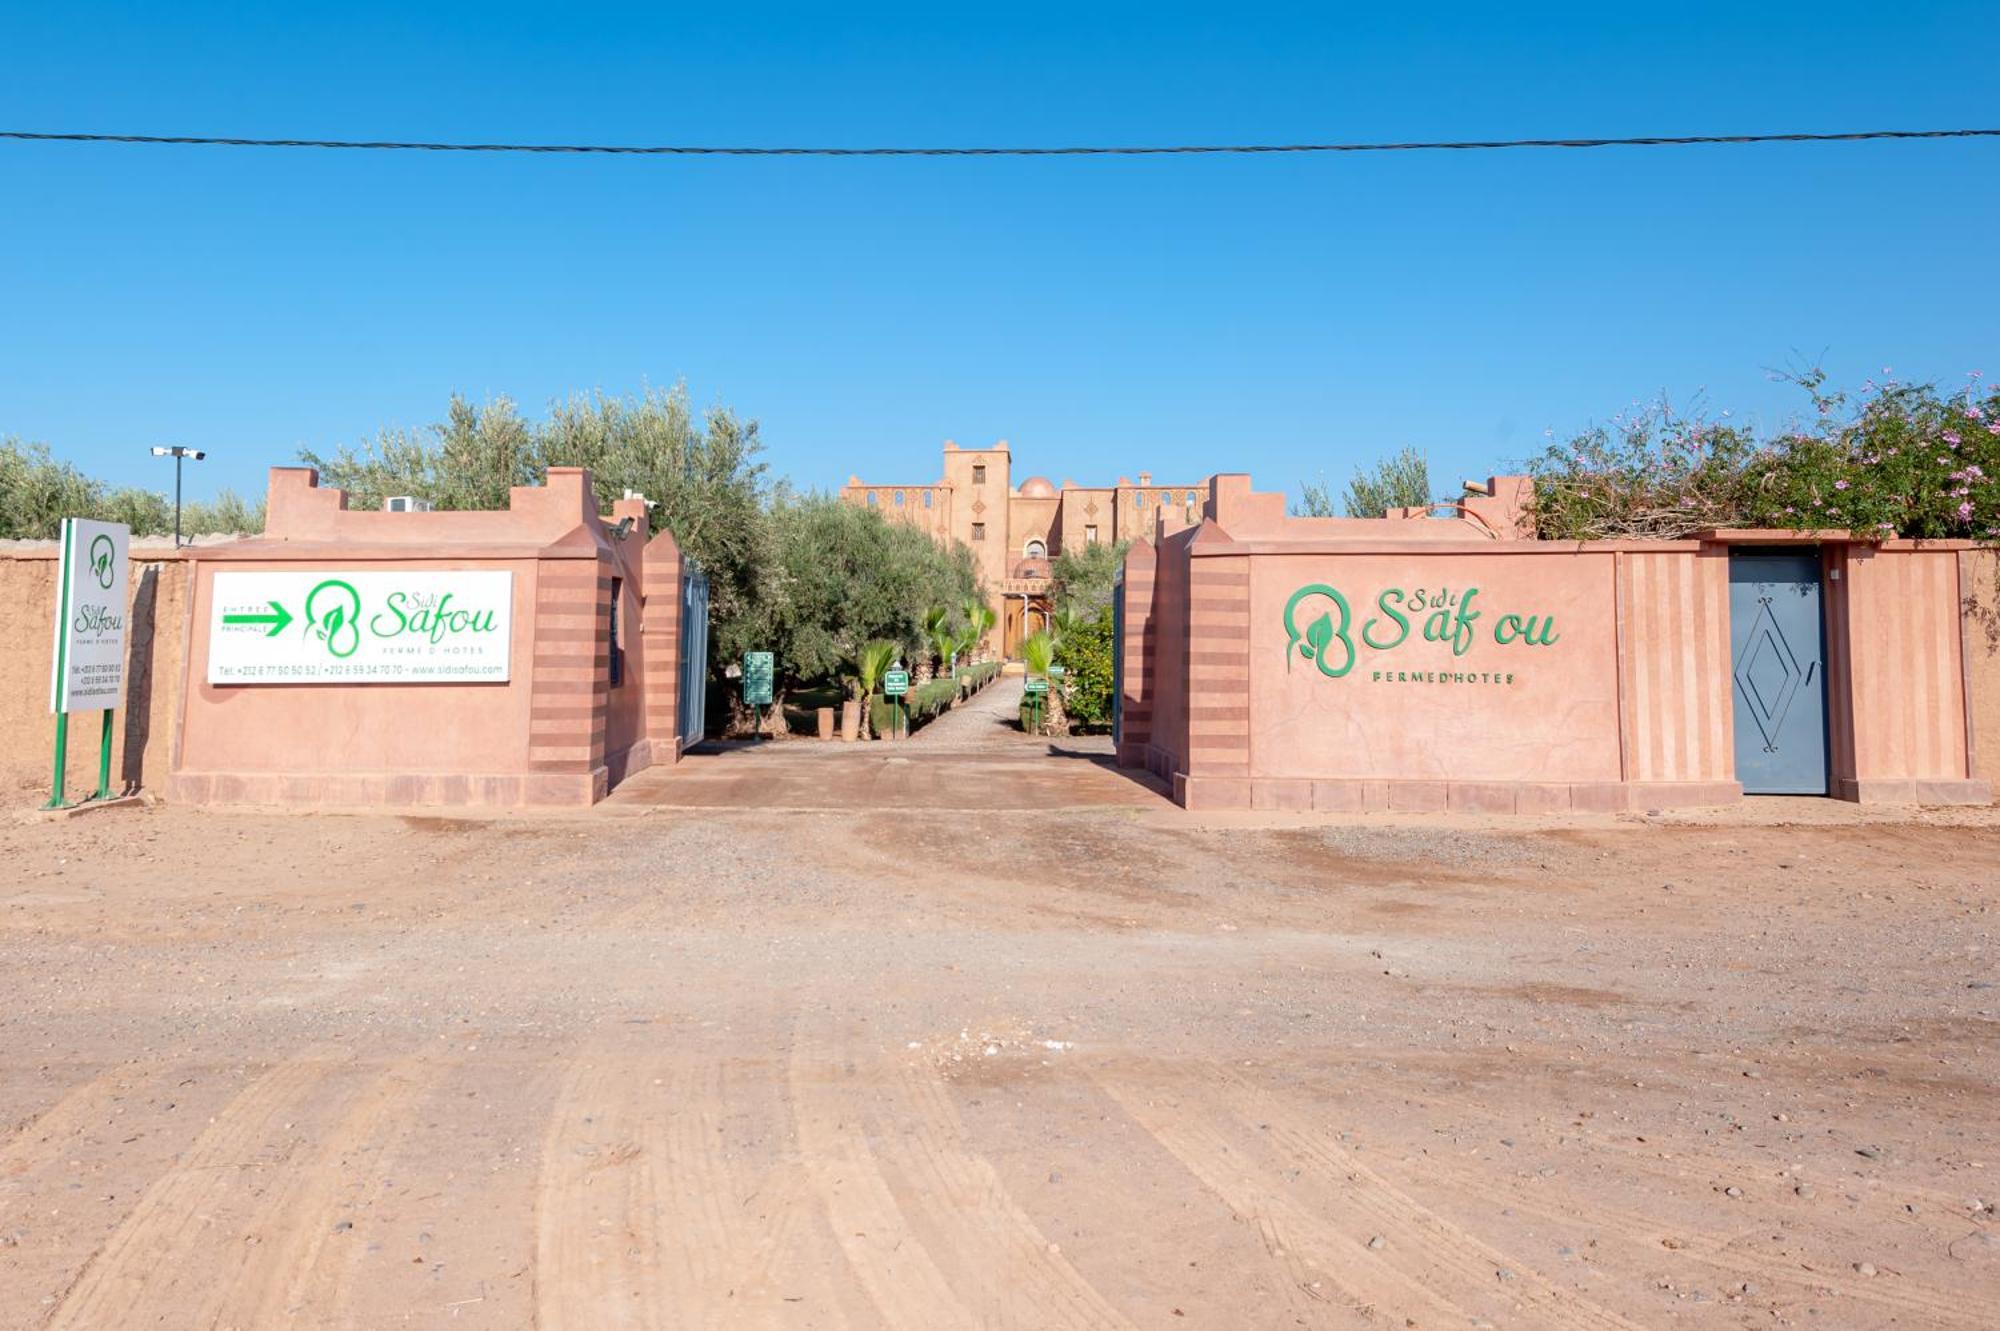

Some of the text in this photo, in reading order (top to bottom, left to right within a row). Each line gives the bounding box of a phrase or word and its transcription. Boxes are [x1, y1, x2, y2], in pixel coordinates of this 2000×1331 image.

[406, 592, 438, 610] Sidi
[1408, 587, 1456, 612] Sidi
[74, 604, 122, 637] Safou
[370, 592, 498, 644] Safou
